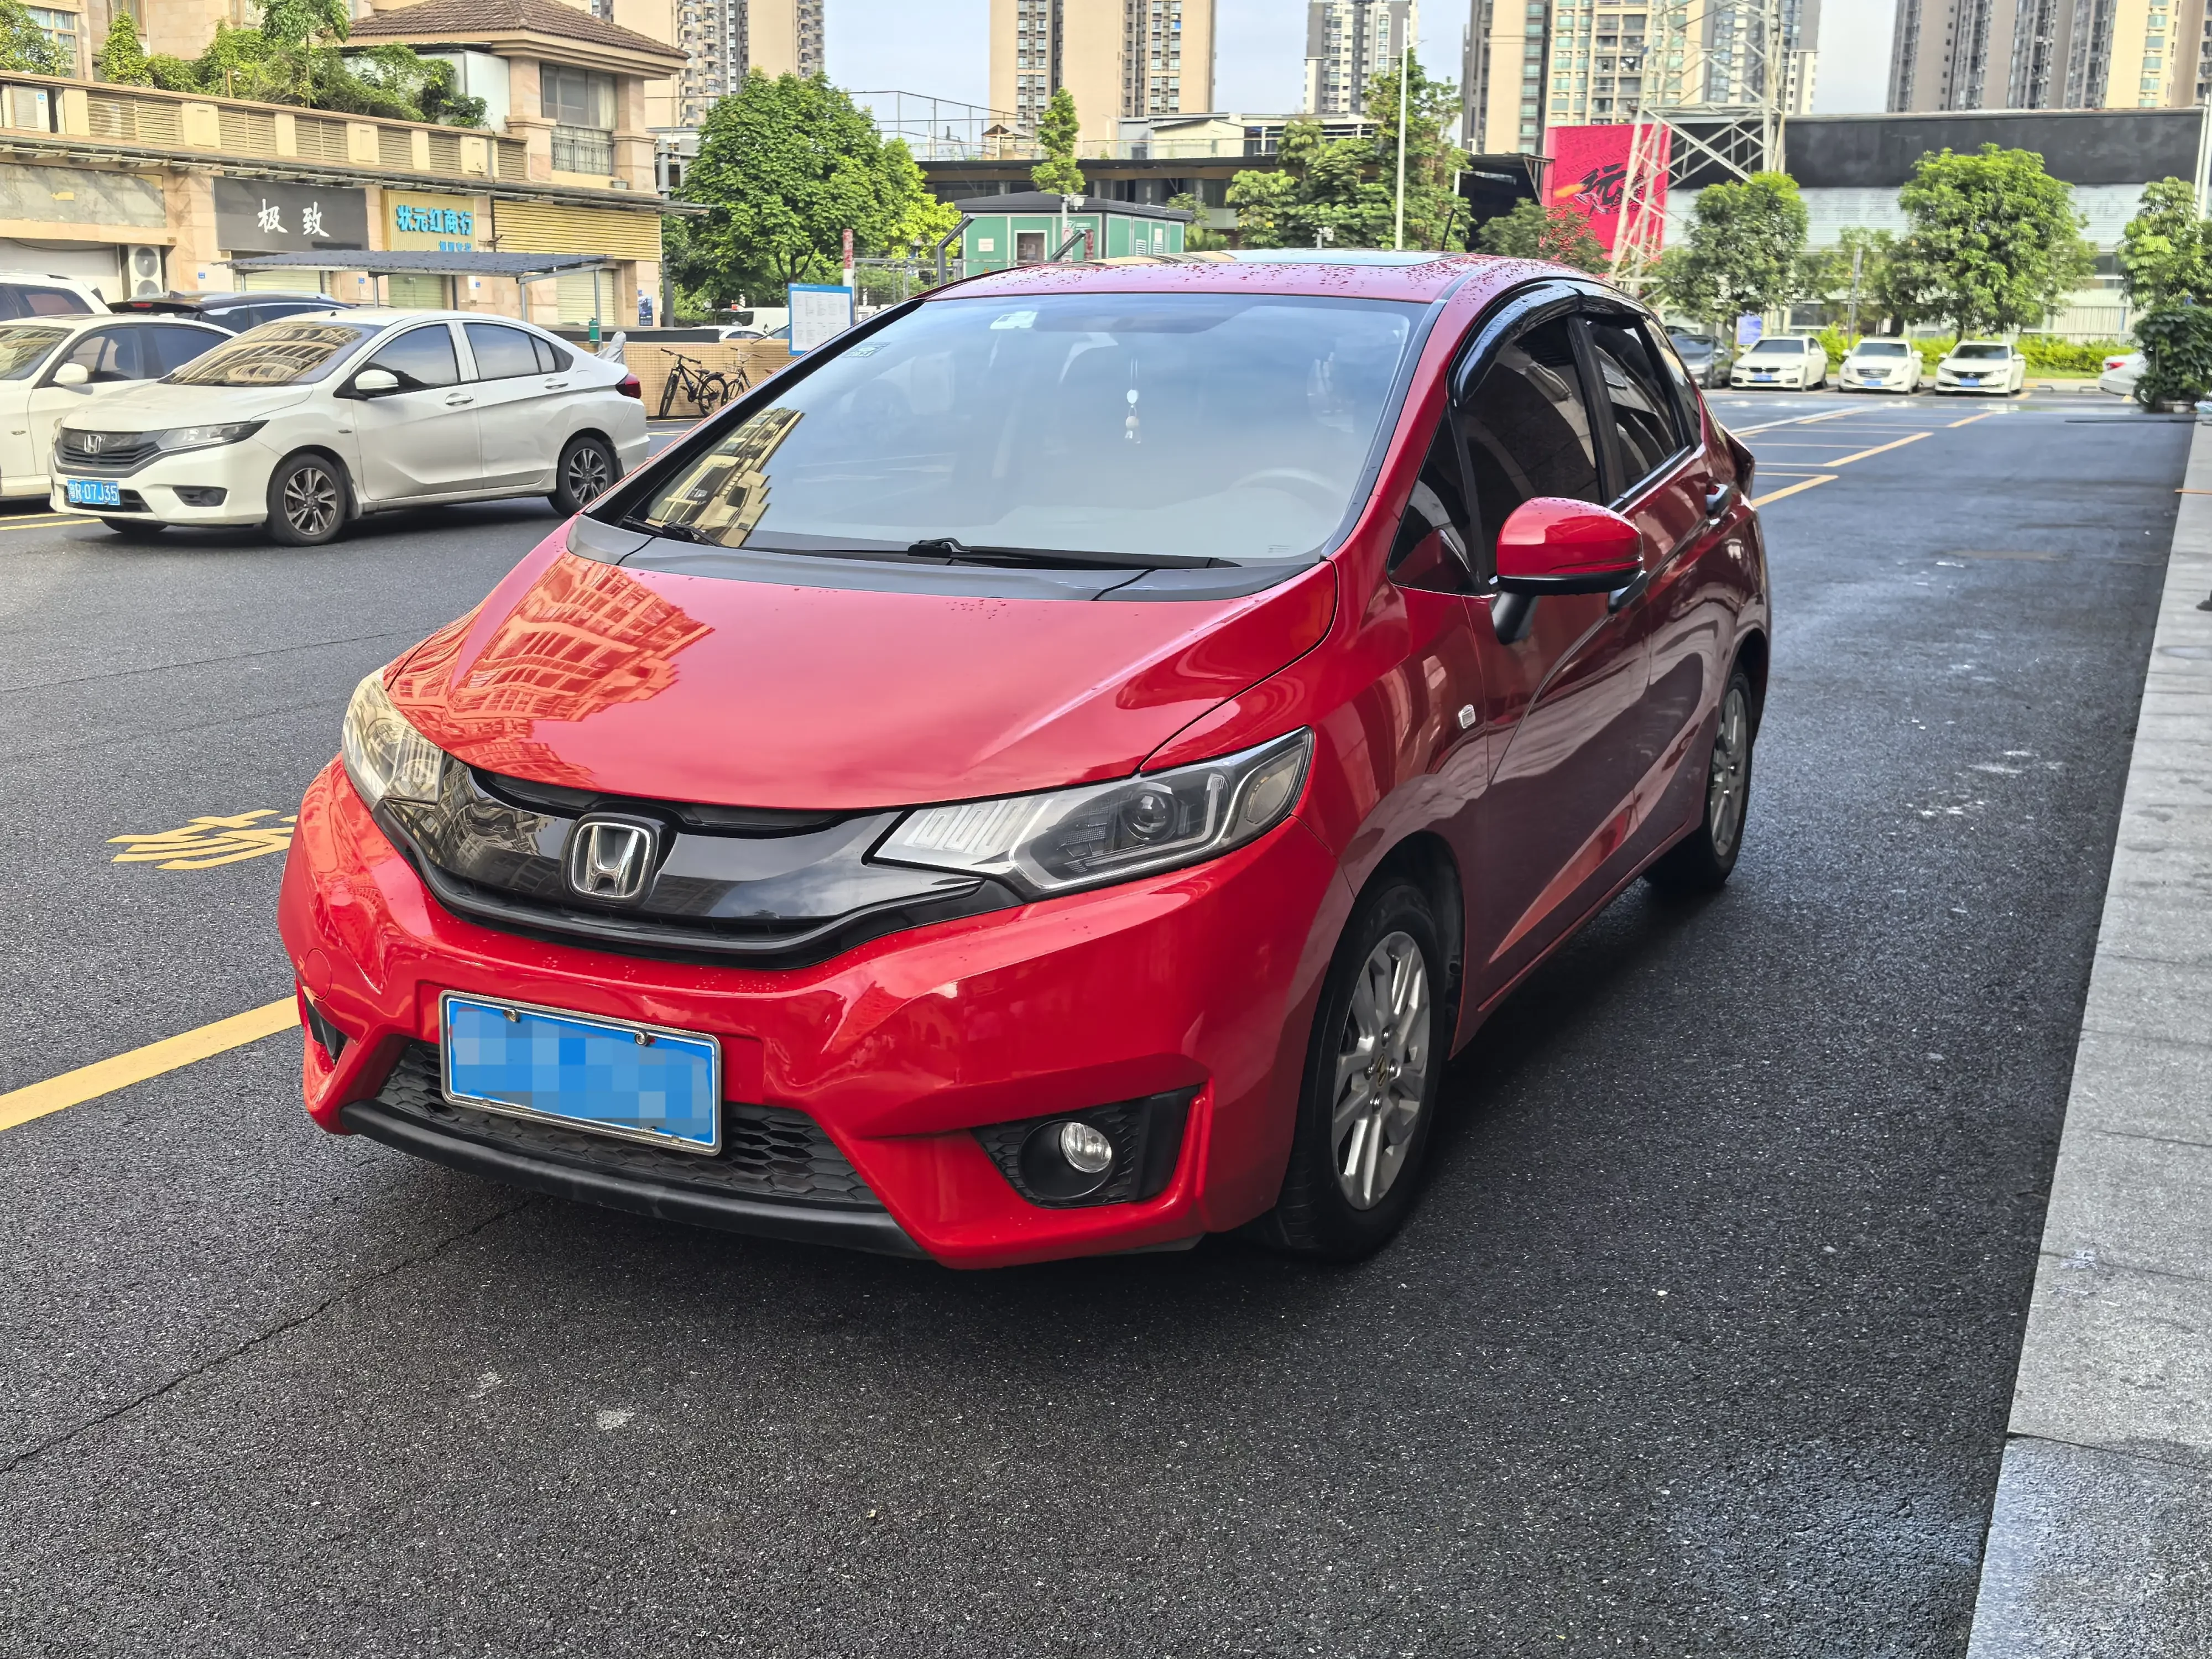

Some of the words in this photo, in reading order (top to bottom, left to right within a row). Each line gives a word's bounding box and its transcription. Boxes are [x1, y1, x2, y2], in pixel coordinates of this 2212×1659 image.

[257, 198, 331, 237] 极致
[396, 205, 473, 236] 状元红商行
